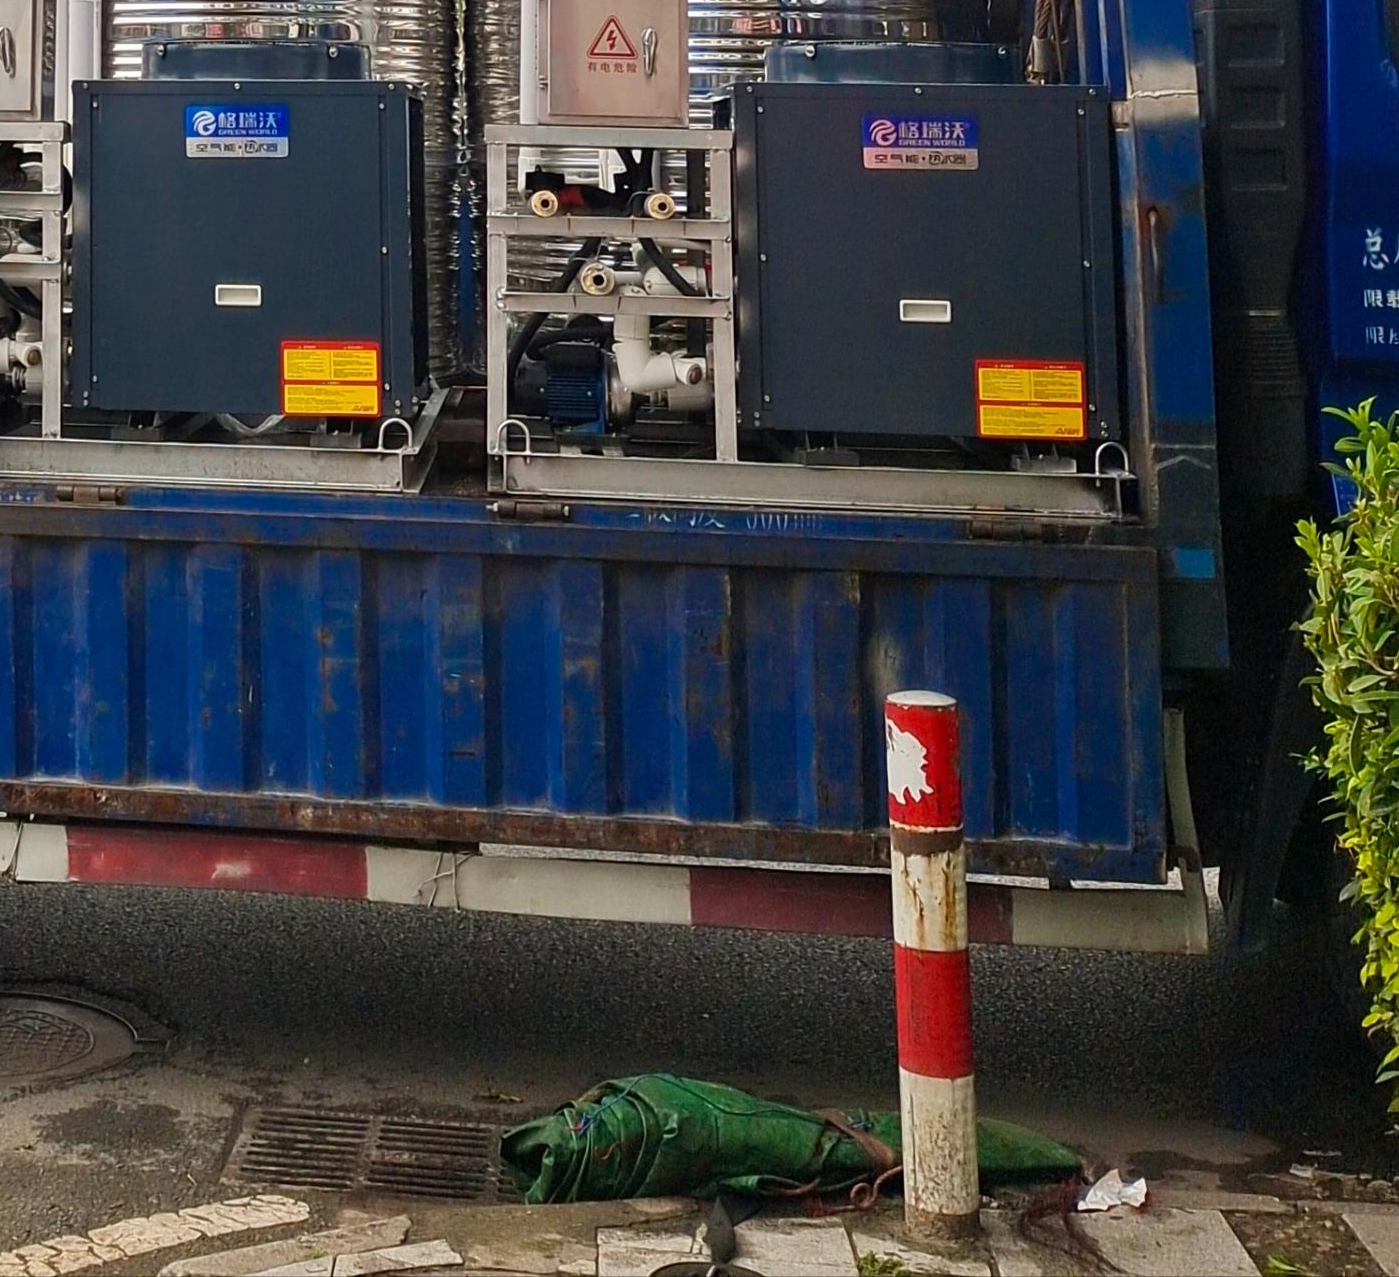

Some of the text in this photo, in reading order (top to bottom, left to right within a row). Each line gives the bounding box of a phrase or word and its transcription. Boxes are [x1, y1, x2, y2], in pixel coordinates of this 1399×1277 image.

[587, 61, 638, 74] 有电危险
[217, 111, 278, 129] 格瑞沃
[898, 121, 965, 139] 格瑞沃
[898, 139, 966, 147] GREEN WORLD
[1362, 227, 1399, 270] 总
